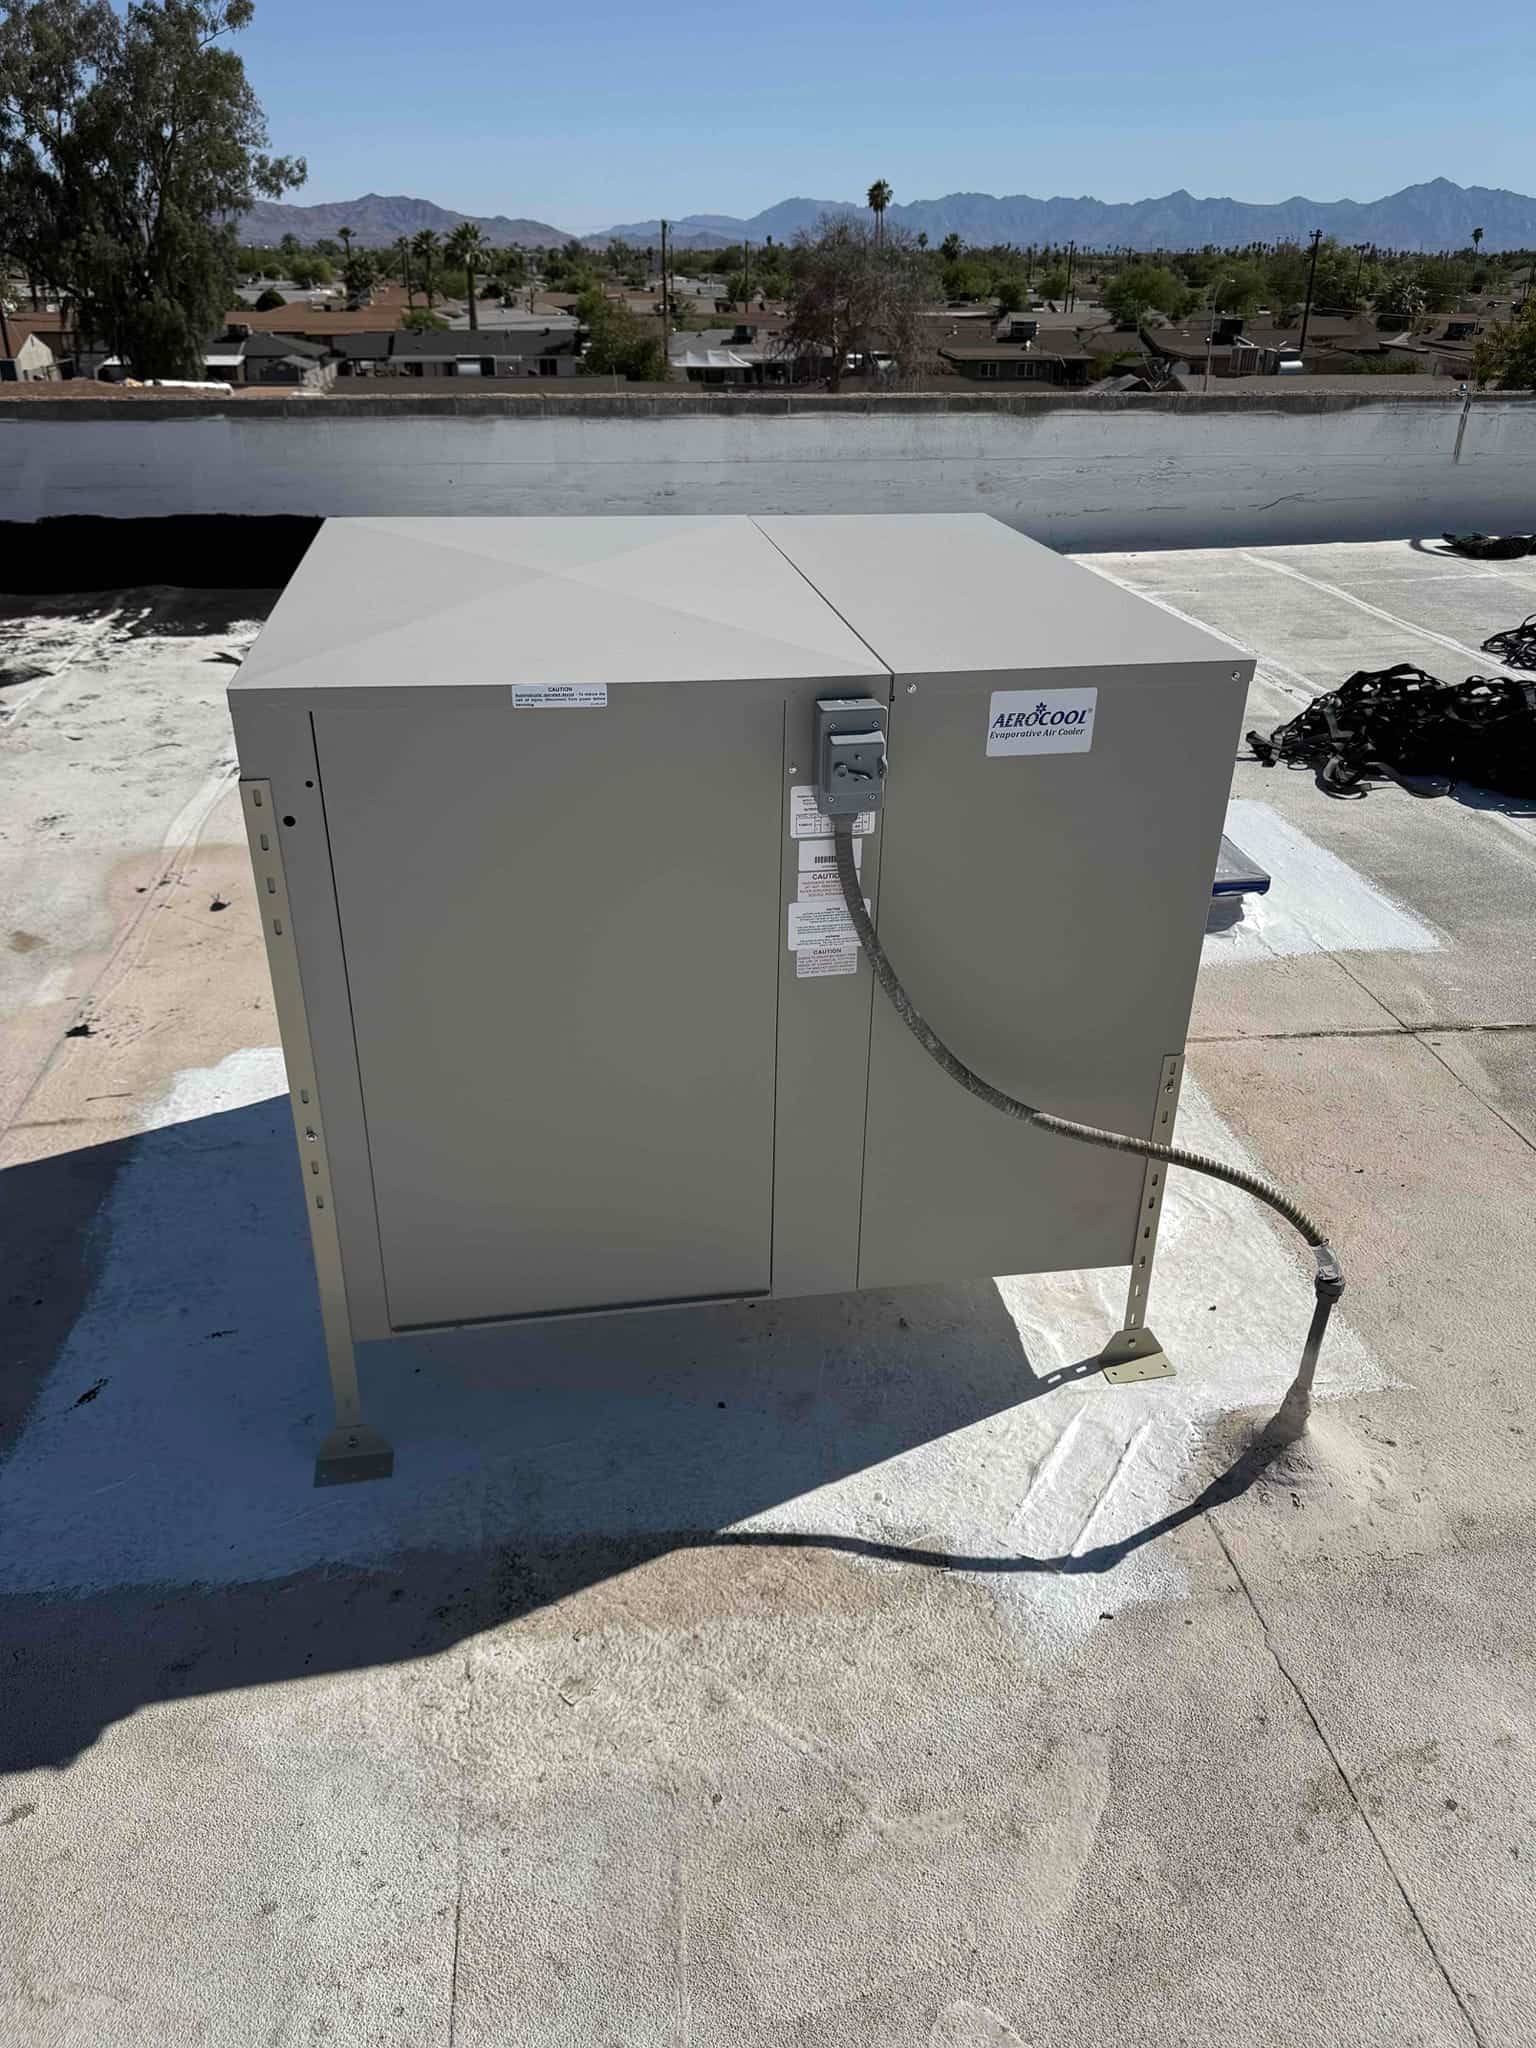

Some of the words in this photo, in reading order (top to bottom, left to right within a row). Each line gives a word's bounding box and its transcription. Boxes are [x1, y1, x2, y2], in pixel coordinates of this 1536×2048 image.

[992, 709, 1087, 728] AEROCOOL
[990, 730, 1042, 740] Evaporative
[1043, 728, 1056, 737] Air
[1058, 727, 1085, 736] Cooler
[812, 872, 840, 880] CAUTIO
[813, 947, 842, 955] CAUTION
